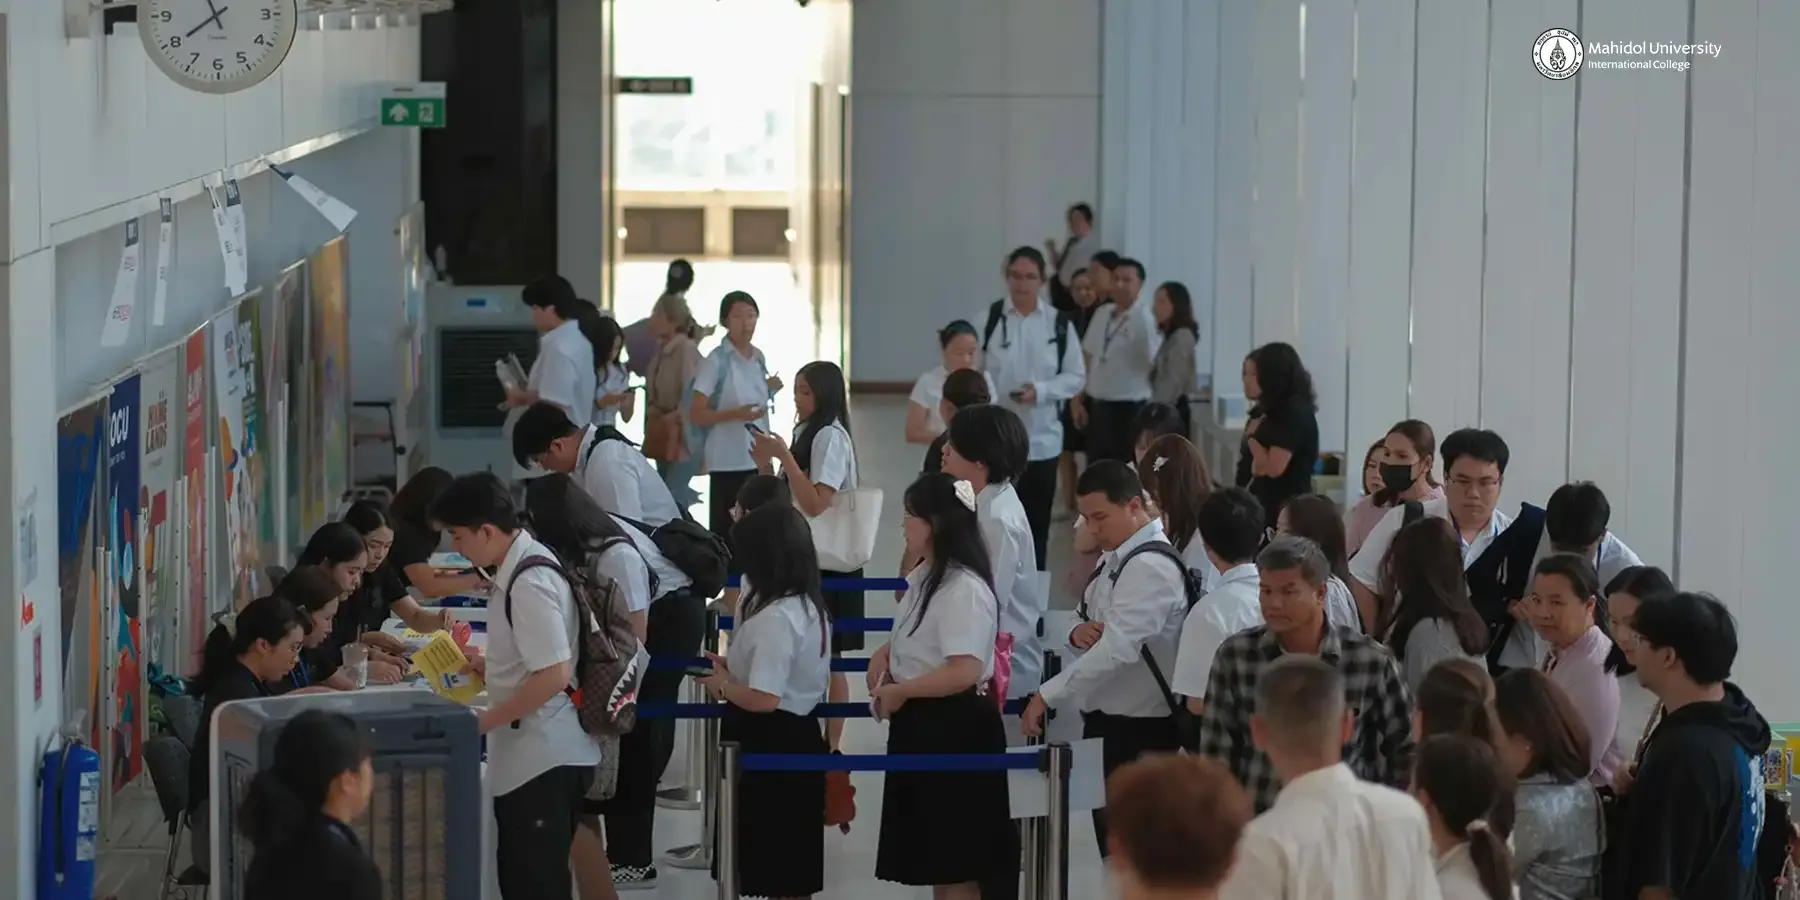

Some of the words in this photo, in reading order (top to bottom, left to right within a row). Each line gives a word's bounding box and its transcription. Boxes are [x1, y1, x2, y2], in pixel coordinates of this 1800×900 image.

[160, 10, 172, 23] 9
[260, 8, 271, 20] 3
[169, 36, 182, 48] 8
[253, 34, 265, 46] 4
[189, 52, 201, 65] 7
[236, 51, 248, 64] 5
[212, 58, 225, 71] 6
